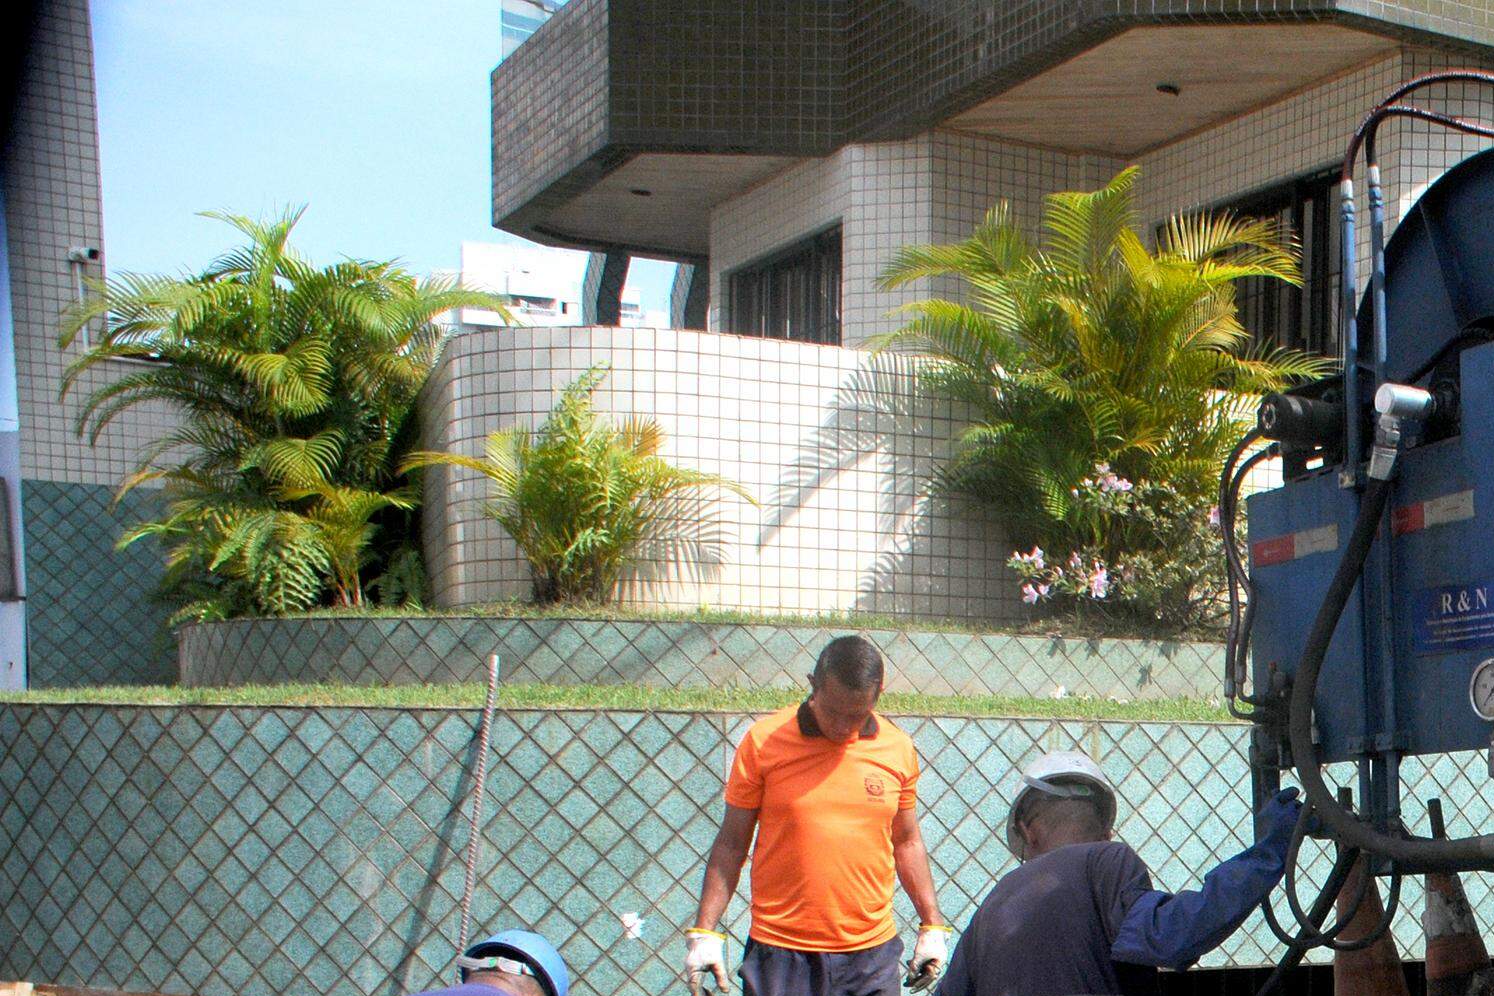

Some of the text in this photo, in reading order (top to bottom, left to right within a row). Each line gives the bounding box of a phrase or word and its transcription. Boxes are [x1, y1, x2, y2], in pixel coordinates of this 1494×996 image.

[1442, 587, 1487, 613] R & N
